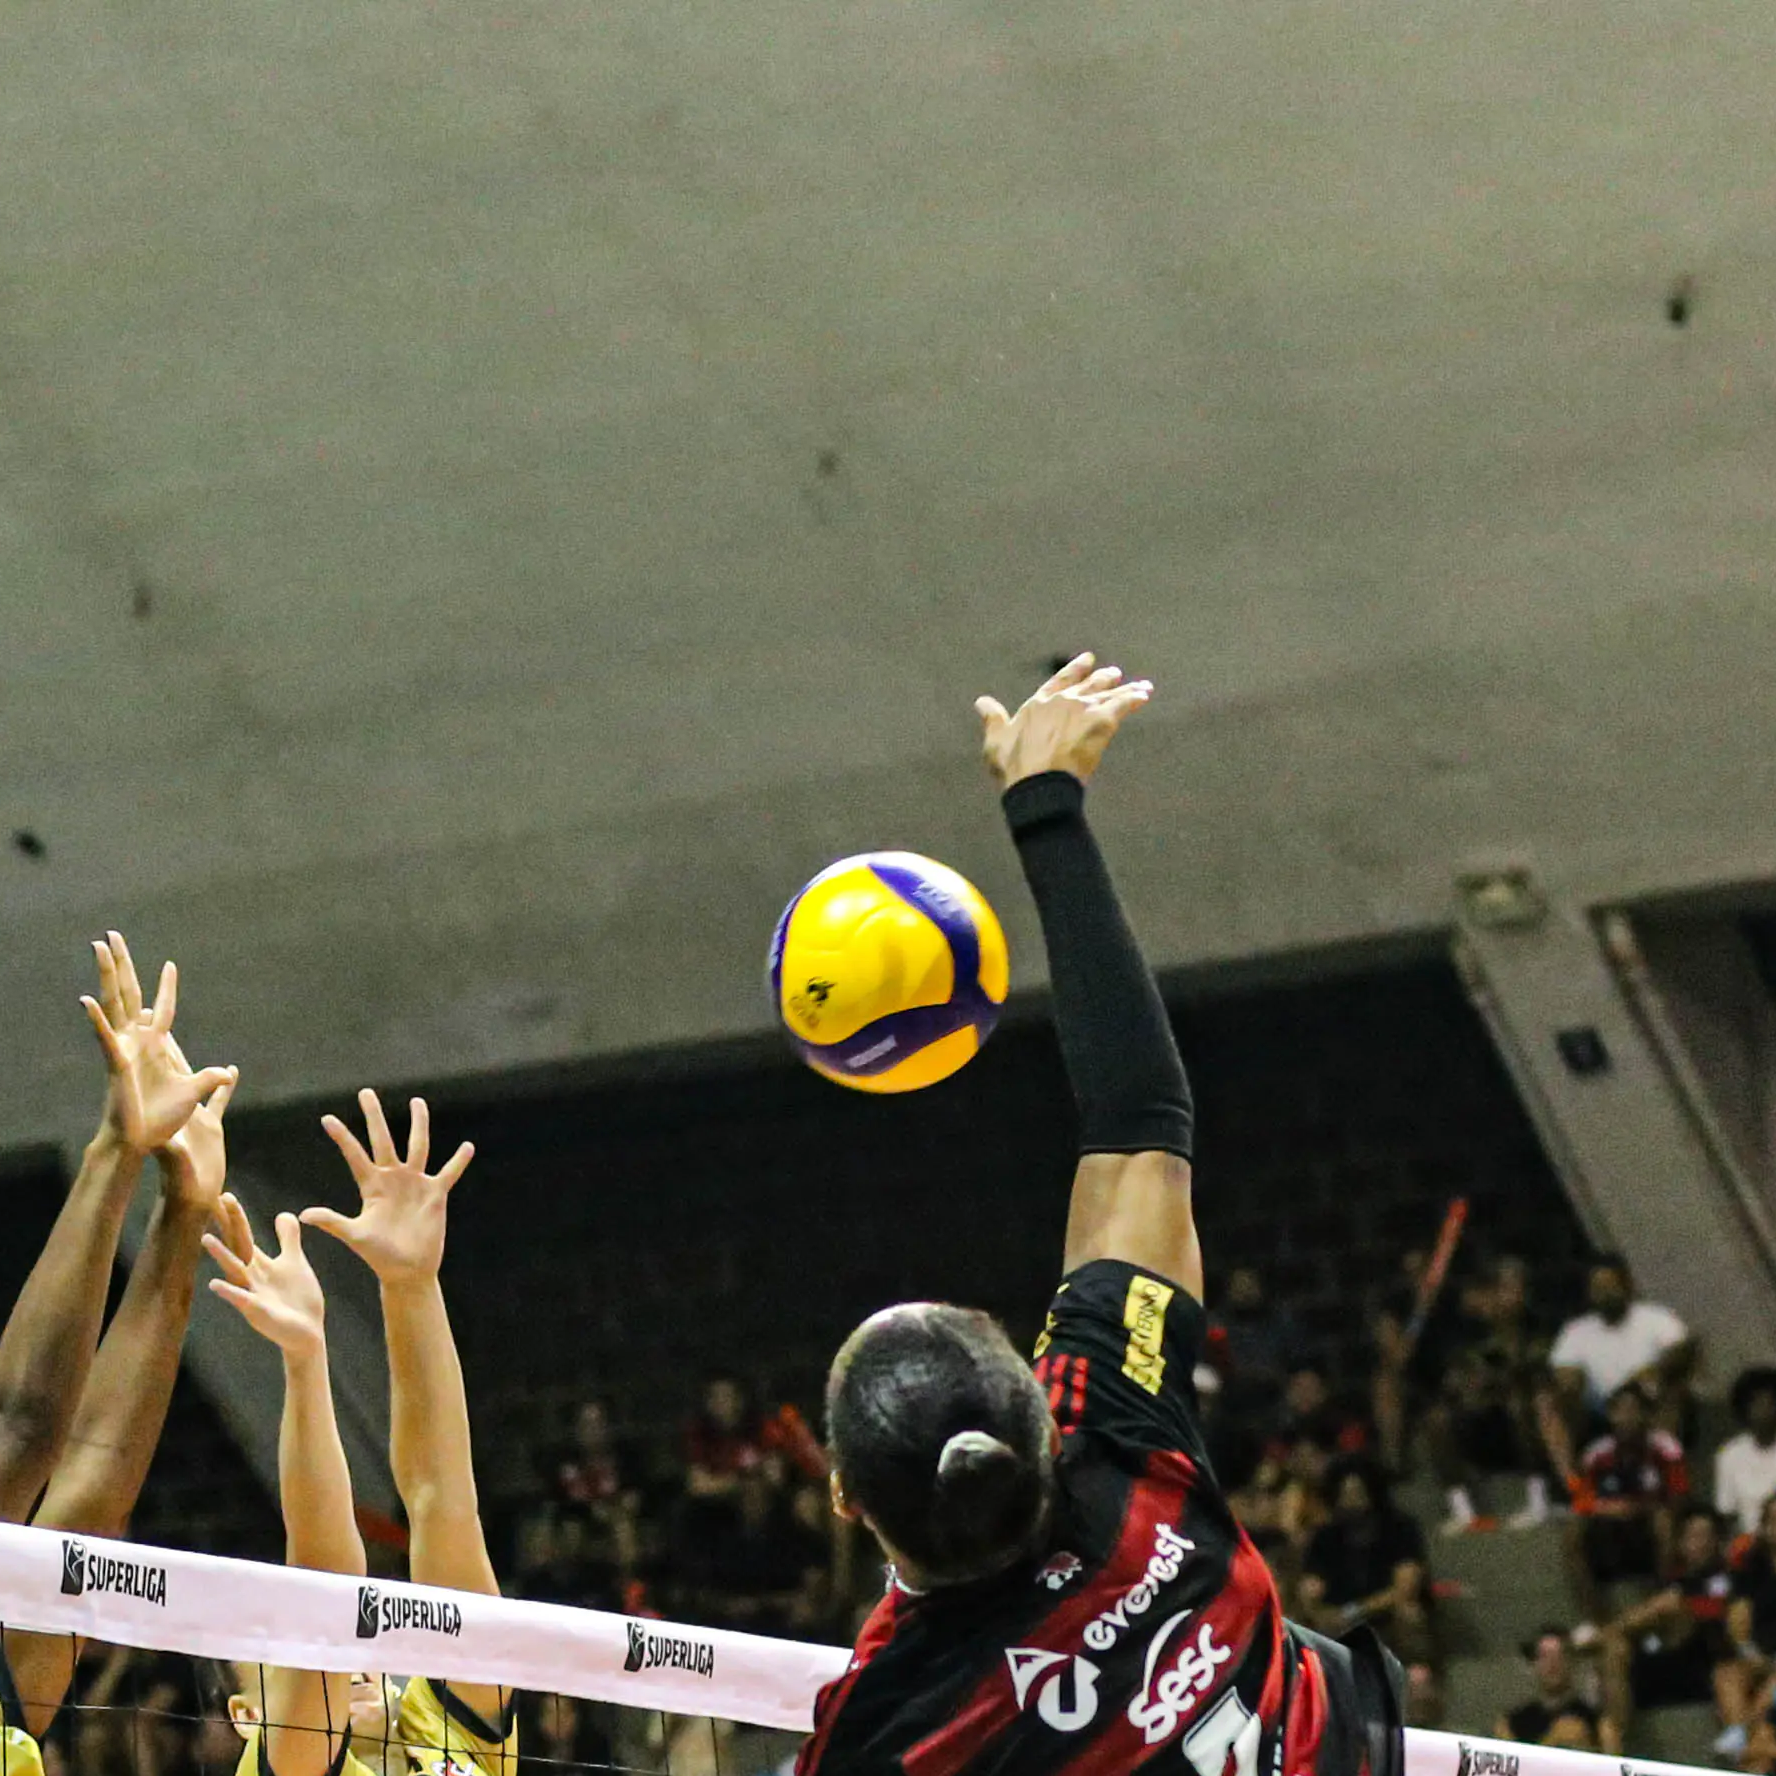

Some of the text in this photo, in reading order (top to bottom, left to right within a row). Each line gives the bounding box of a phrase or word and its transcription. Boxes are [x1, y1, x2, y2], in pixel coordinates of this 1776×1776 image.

[86, 1553, 166, 1607] SUPERLIGA
[1082, 1523, 1195, 1651] everest
[382, 1596, 462, 1637] SUPERLIGA
[645, 1635, 713, 1679] SUPERLIGA
[1128, 1622, 1231, 1744] Sesc
